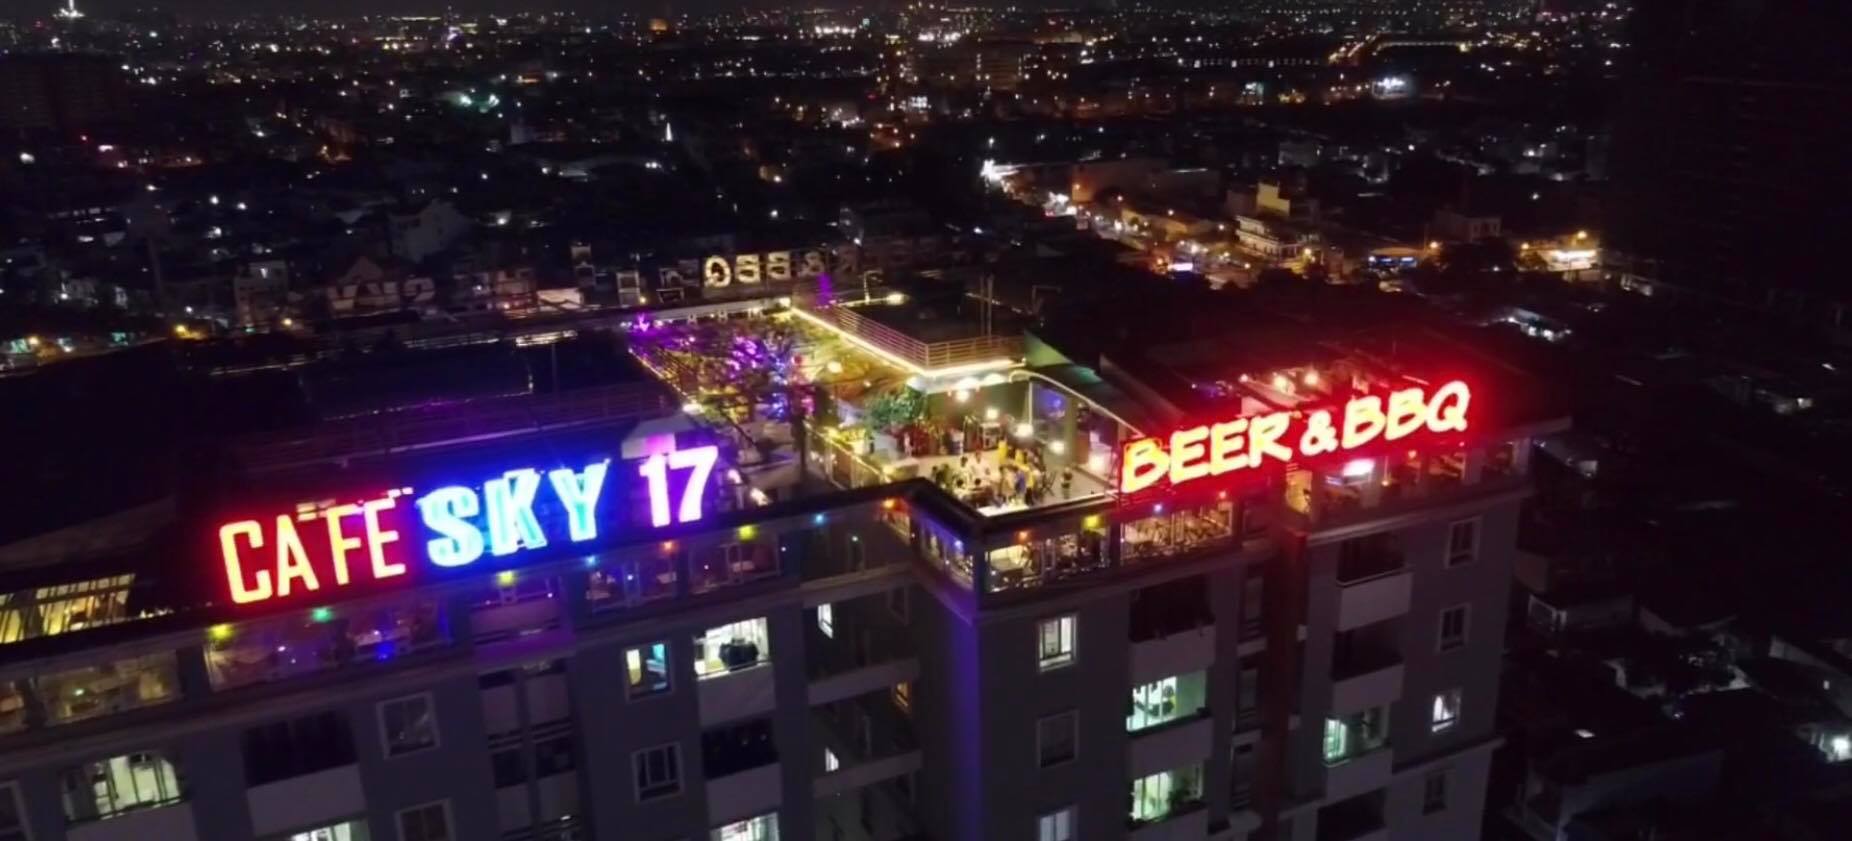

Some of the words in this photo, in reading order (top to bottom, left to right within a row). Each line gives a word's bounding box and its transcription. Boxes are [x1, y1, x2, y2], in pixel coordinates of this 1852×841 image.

[1121, 411, 1293, 493] BEER
[1299, 411, 1339, 456] &
[1342, 380, 1471, 449] BBQ
[219, 498, 406, 605] CAFE
[417, 459, 611, 568] SKY
[639, 446, 719, 529] 17
